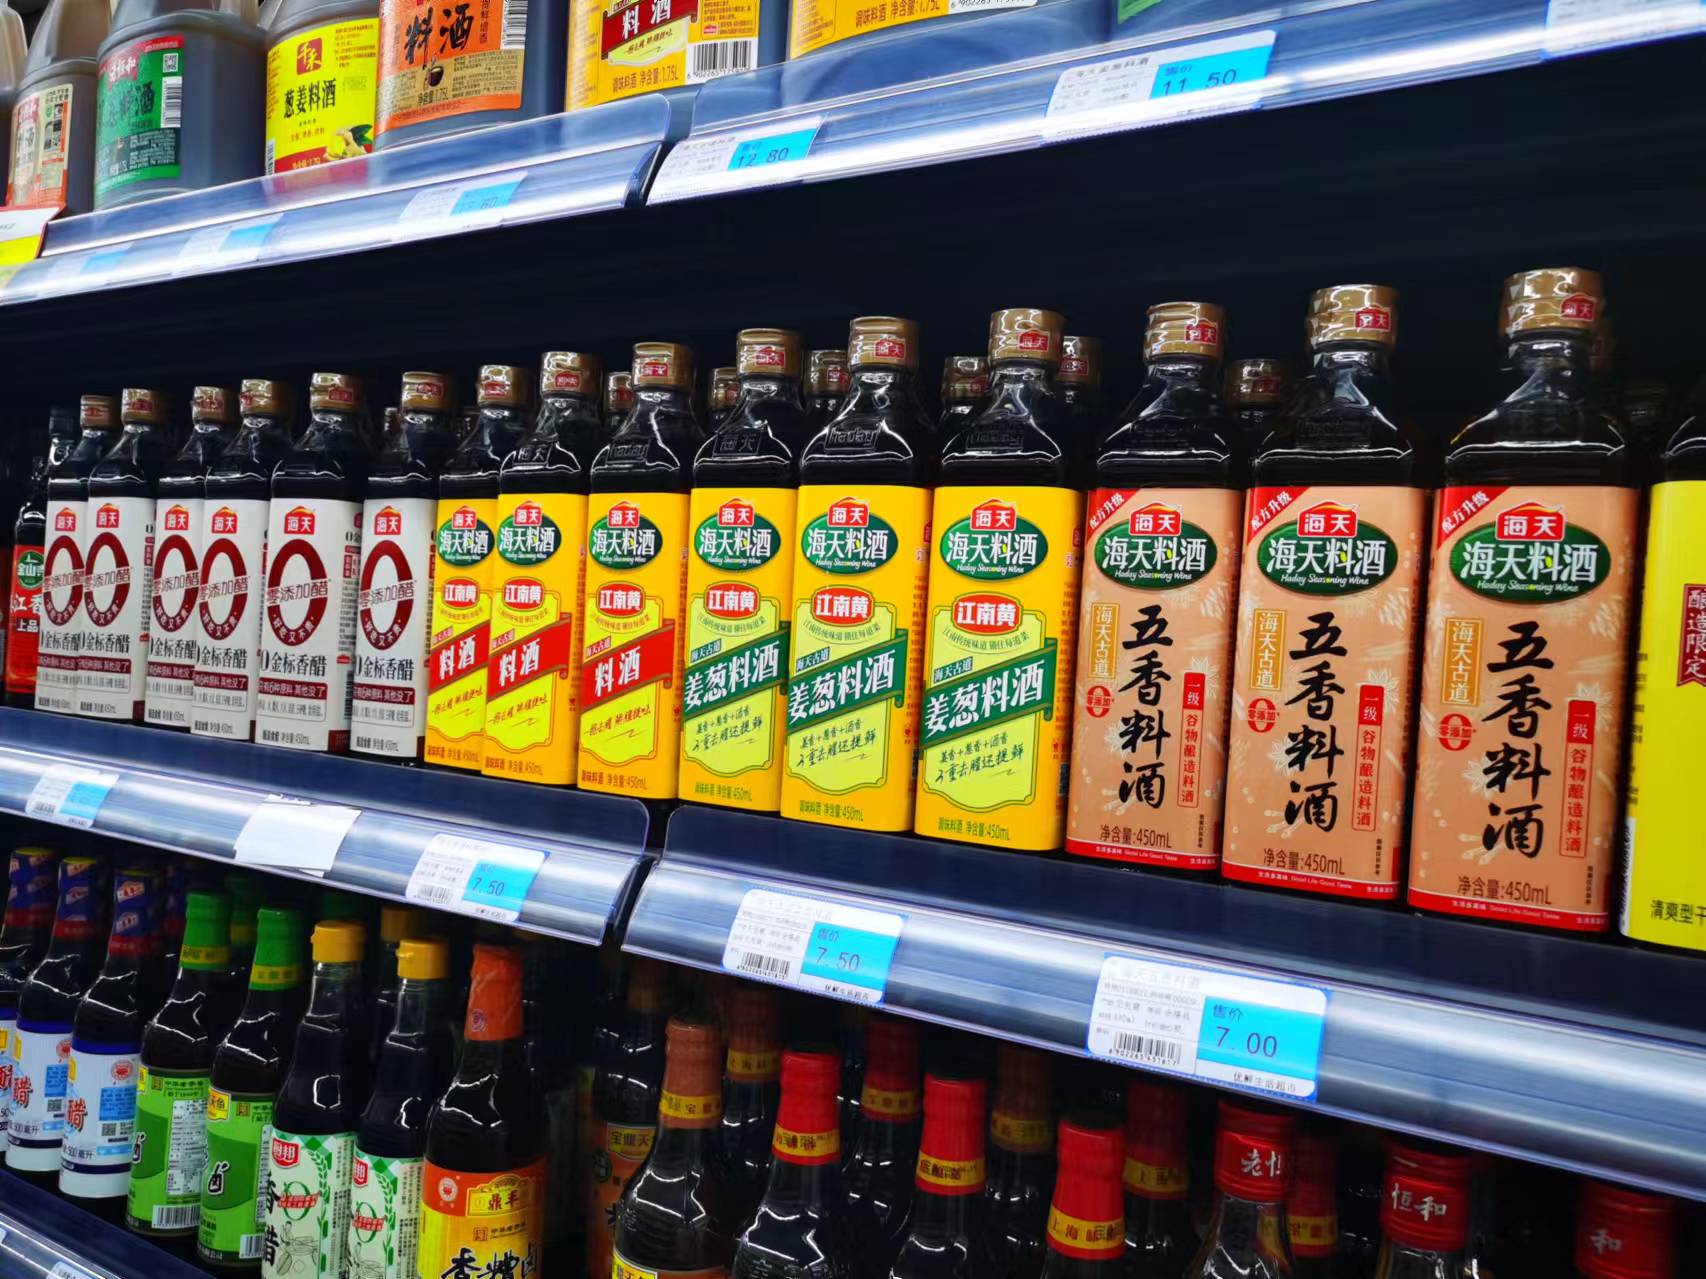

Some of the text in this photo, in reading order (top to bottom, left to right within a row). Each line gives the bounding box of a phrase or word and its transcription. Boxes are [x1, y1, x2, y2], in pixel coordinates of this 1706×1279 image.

[622, 0, 671, 39] 料酒
[404, 3, 474, 67] 料酒
[283, 78, 336, 118] 葱姜料酒
[1565, 304, 1592, 316] 海天
[56, 515, 75, 529] 海天
[99, 511, 119, 525] 海天
[167, 513, 188, 527] 海天
[453, 513, 475, 527] 海天
[517, 509, 539, 523] 海天
[611, 510, 636, 524] 海天
[722, 507, 750, 523] 海天
[832, 507, 864, 524] 海天
[975, 510, 1011, 527] 海天
[1088, 493, 1125, 529] 配方升级
[1135, 514, 1176, 532] 海天
[1251, 491, 1293, 530] 配方升级
[1304, 513, 1350, 533] 海天
[1441, 491, 1490, 534] 配方升级
[214, 516, 235, 531] 海天
[287, 516, 314, 532] 海天
[377, 517, 398, 532] 海天
[1504, 515, 1558, 537] 海天
[439, 529, 489, 554] 海天料酒
[500, 526, 556, 553] 海天料酒
[592, 528, 655, 556] 海天料酒
[699, 527, 772, 557] 海天料酒
[807, 528, 889, 560] 海天料酒
[946, 532, 1038, 565] 海天料酒
[1102, 536, 1207, 571] 海天料酒
[1266, 537, 1387, 576] 海天料酒
[1460, 540, 1599, 583] 海天料酒
[1115, 569, 1192, 582] Haday Seasoning Wine
[1281, 574, 1369, 587] Haday Seasoning Wine
[1477, 580, 1578, 595] Haday Seasoning Wine
[268, 581, 328, 605] 零添加醋
[360, 584, 414, 608] 零添加醋
[445, 585, 477, 602] 江南黄
[505, 585, 541, 603] 江南黄
[600, 590, 641, 611] 江南黄
[708, 590, 755, 612] 江南黄
[815, 593, 869, 618] 江南黄
[17, 618, 39, 633] 上品
[957, 602, 1016, 627] 江南黄
[1095, 606, 1112, 677] 海天古道
[1256, 612, 1279, 688] 海天古道
[439, 634, 476, 680] 料酒
[499, 638, 540, 687] 料酒
[796, 647, 829, 673] 海天古道
[934, 656, 973, 682] 海天古道
[1450, 621, 1474, 704] 海天古道
[595, 646, 640, 697] 料酒
[684, 640, 779, 712] 姜葱料酒
[294, 684, 325, 698] 其他没了
[384, 687, 413, 704] 其他没了
[788, 649, 896, 725] 姜葱料酒
[925, 660, 1045, 739] 姜葱料酒
[1187, 683, 1201, 705] 一级
[1118, 605, 1173, 809] 五香料酒
[1362, 696, 1378, 721] 一级
[1285, 611, 1348, 832] 五香料酒
[1573, 712, 1590, 740] 一级
[1481, 621, 1554, 859] 五香料酒
[1181, 714, 1198, 802] 谷物酿造料酒
[1357, 730, 1376, 827] 谷物酿造料酒
[823, 802, 864, 822] 净含量:450mL
[1565, 749, 1587, 853] 谷物酿造料酒
[938, 817, 1010, 841] 调味料酒 净含量:450mL
[1100, 824, 1172, 848] 净含量:450mL
[1263, 848, 1345, 875] 净含量:450mL
[472, 878, 505, 896] 7.50
[1457, 875, 1552, 905] 净含量:450mL
[816, 946, 861, 972] 7.50
[1213, 1004, 1243, 1023] 售价
[1215, 1026, 1278, 1058] 7.00
[1233, 1071, 1296, 1093] 优鲜生活超市
[67, 1098, 88, 1132] 醋
[488, 1189, 520, 1211] 鼎丰
[1391, 1183, 1447, 1222] 恒和
